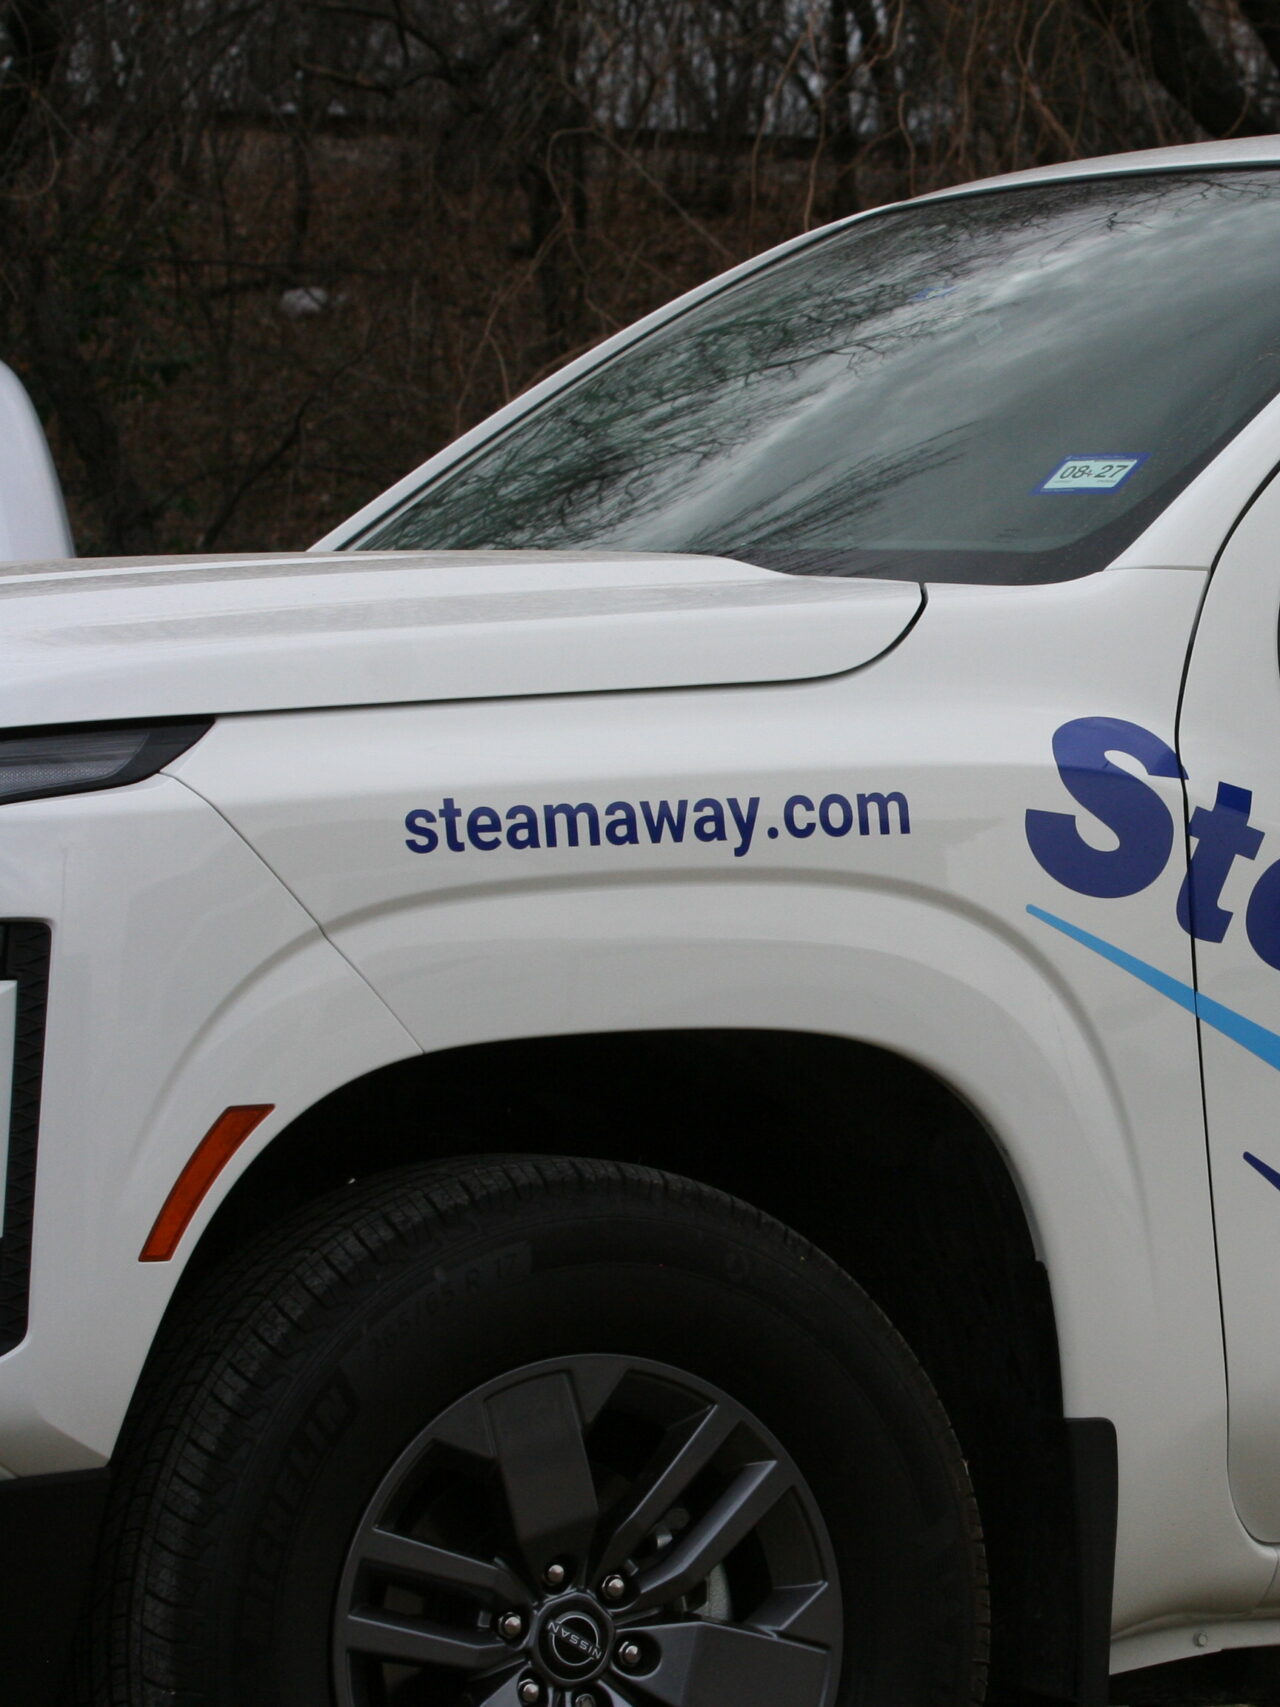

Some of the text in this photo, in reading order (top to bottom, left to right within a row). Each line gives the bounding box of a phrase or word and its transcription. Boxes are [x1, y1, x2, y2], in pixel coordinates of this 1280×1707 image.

[1059, 464, 1130, 479] 08 27
[404, 790, 912, 857] steamaway.com
[242, 1387, 351, 1646] MICHELIN
[547, 1621, 602, 1660] NISSAN
